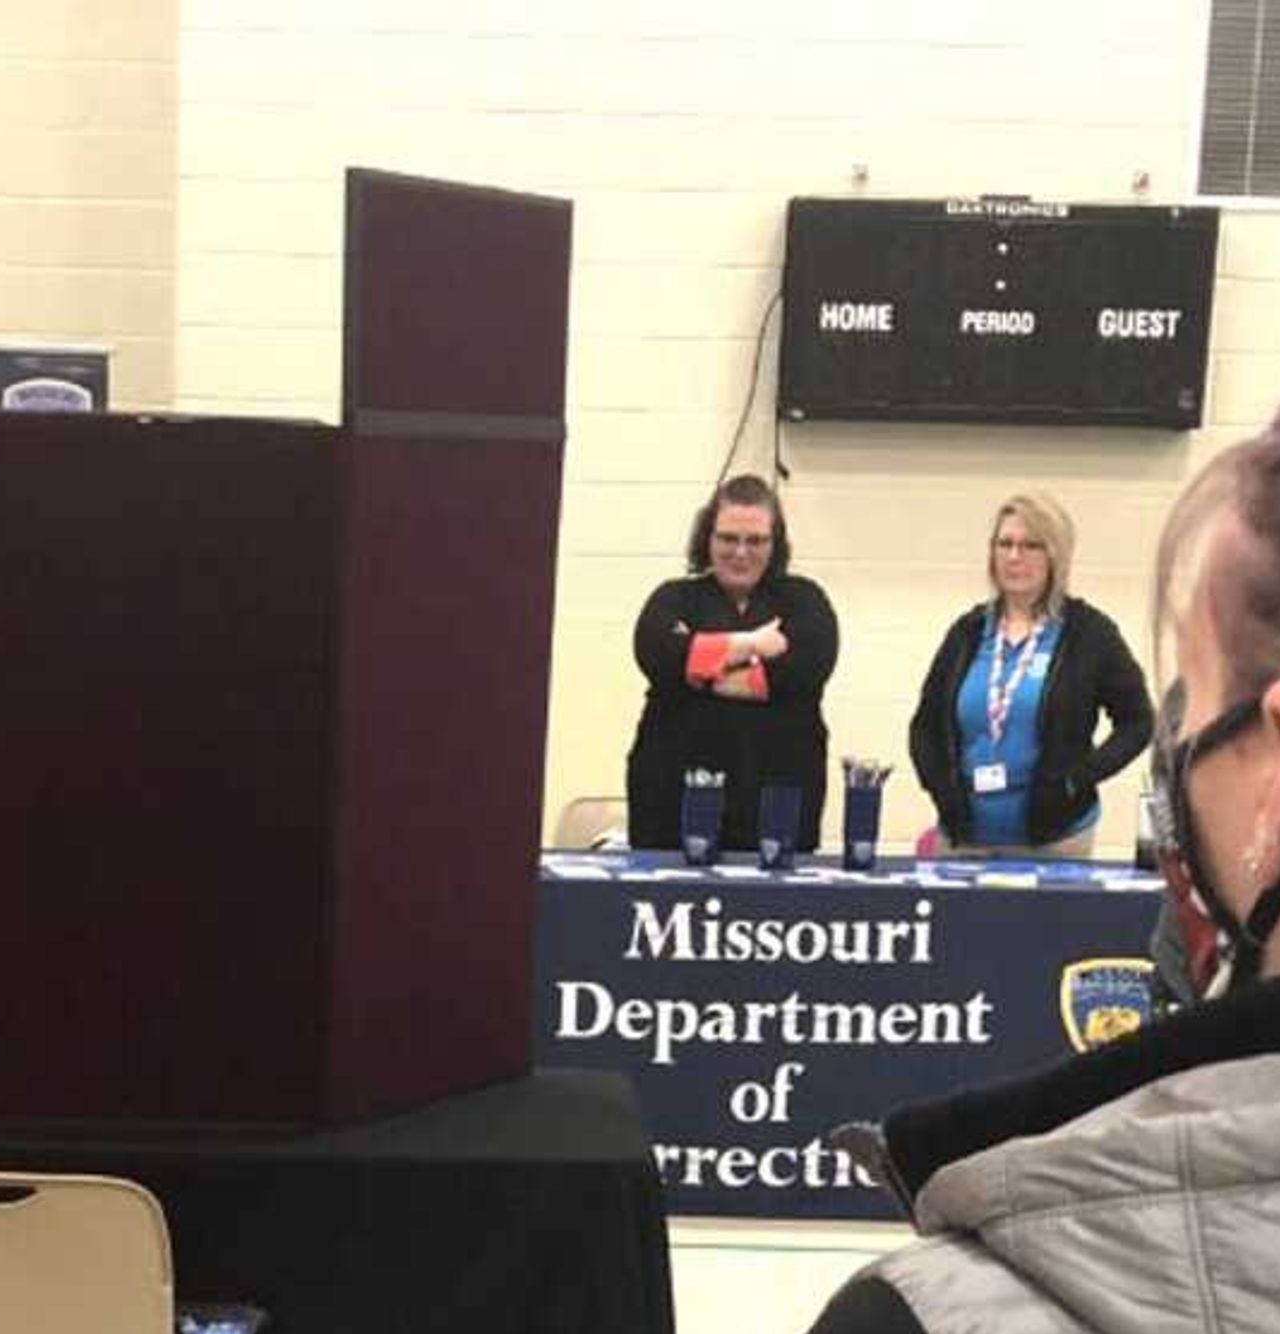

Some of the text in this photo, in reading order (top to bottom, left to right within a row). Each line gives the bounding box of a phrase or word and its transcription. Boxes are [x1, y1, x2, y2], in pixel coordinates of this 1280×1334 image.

[821, 304, 1181, 338] HOME PERIOD GUEST
[623, 900, 932, 964] Missouri
[555, 981, 993, 1065] Department
[730, 1063, 805, 1124] of
[651, 1137, 880, 1189] rrecti
